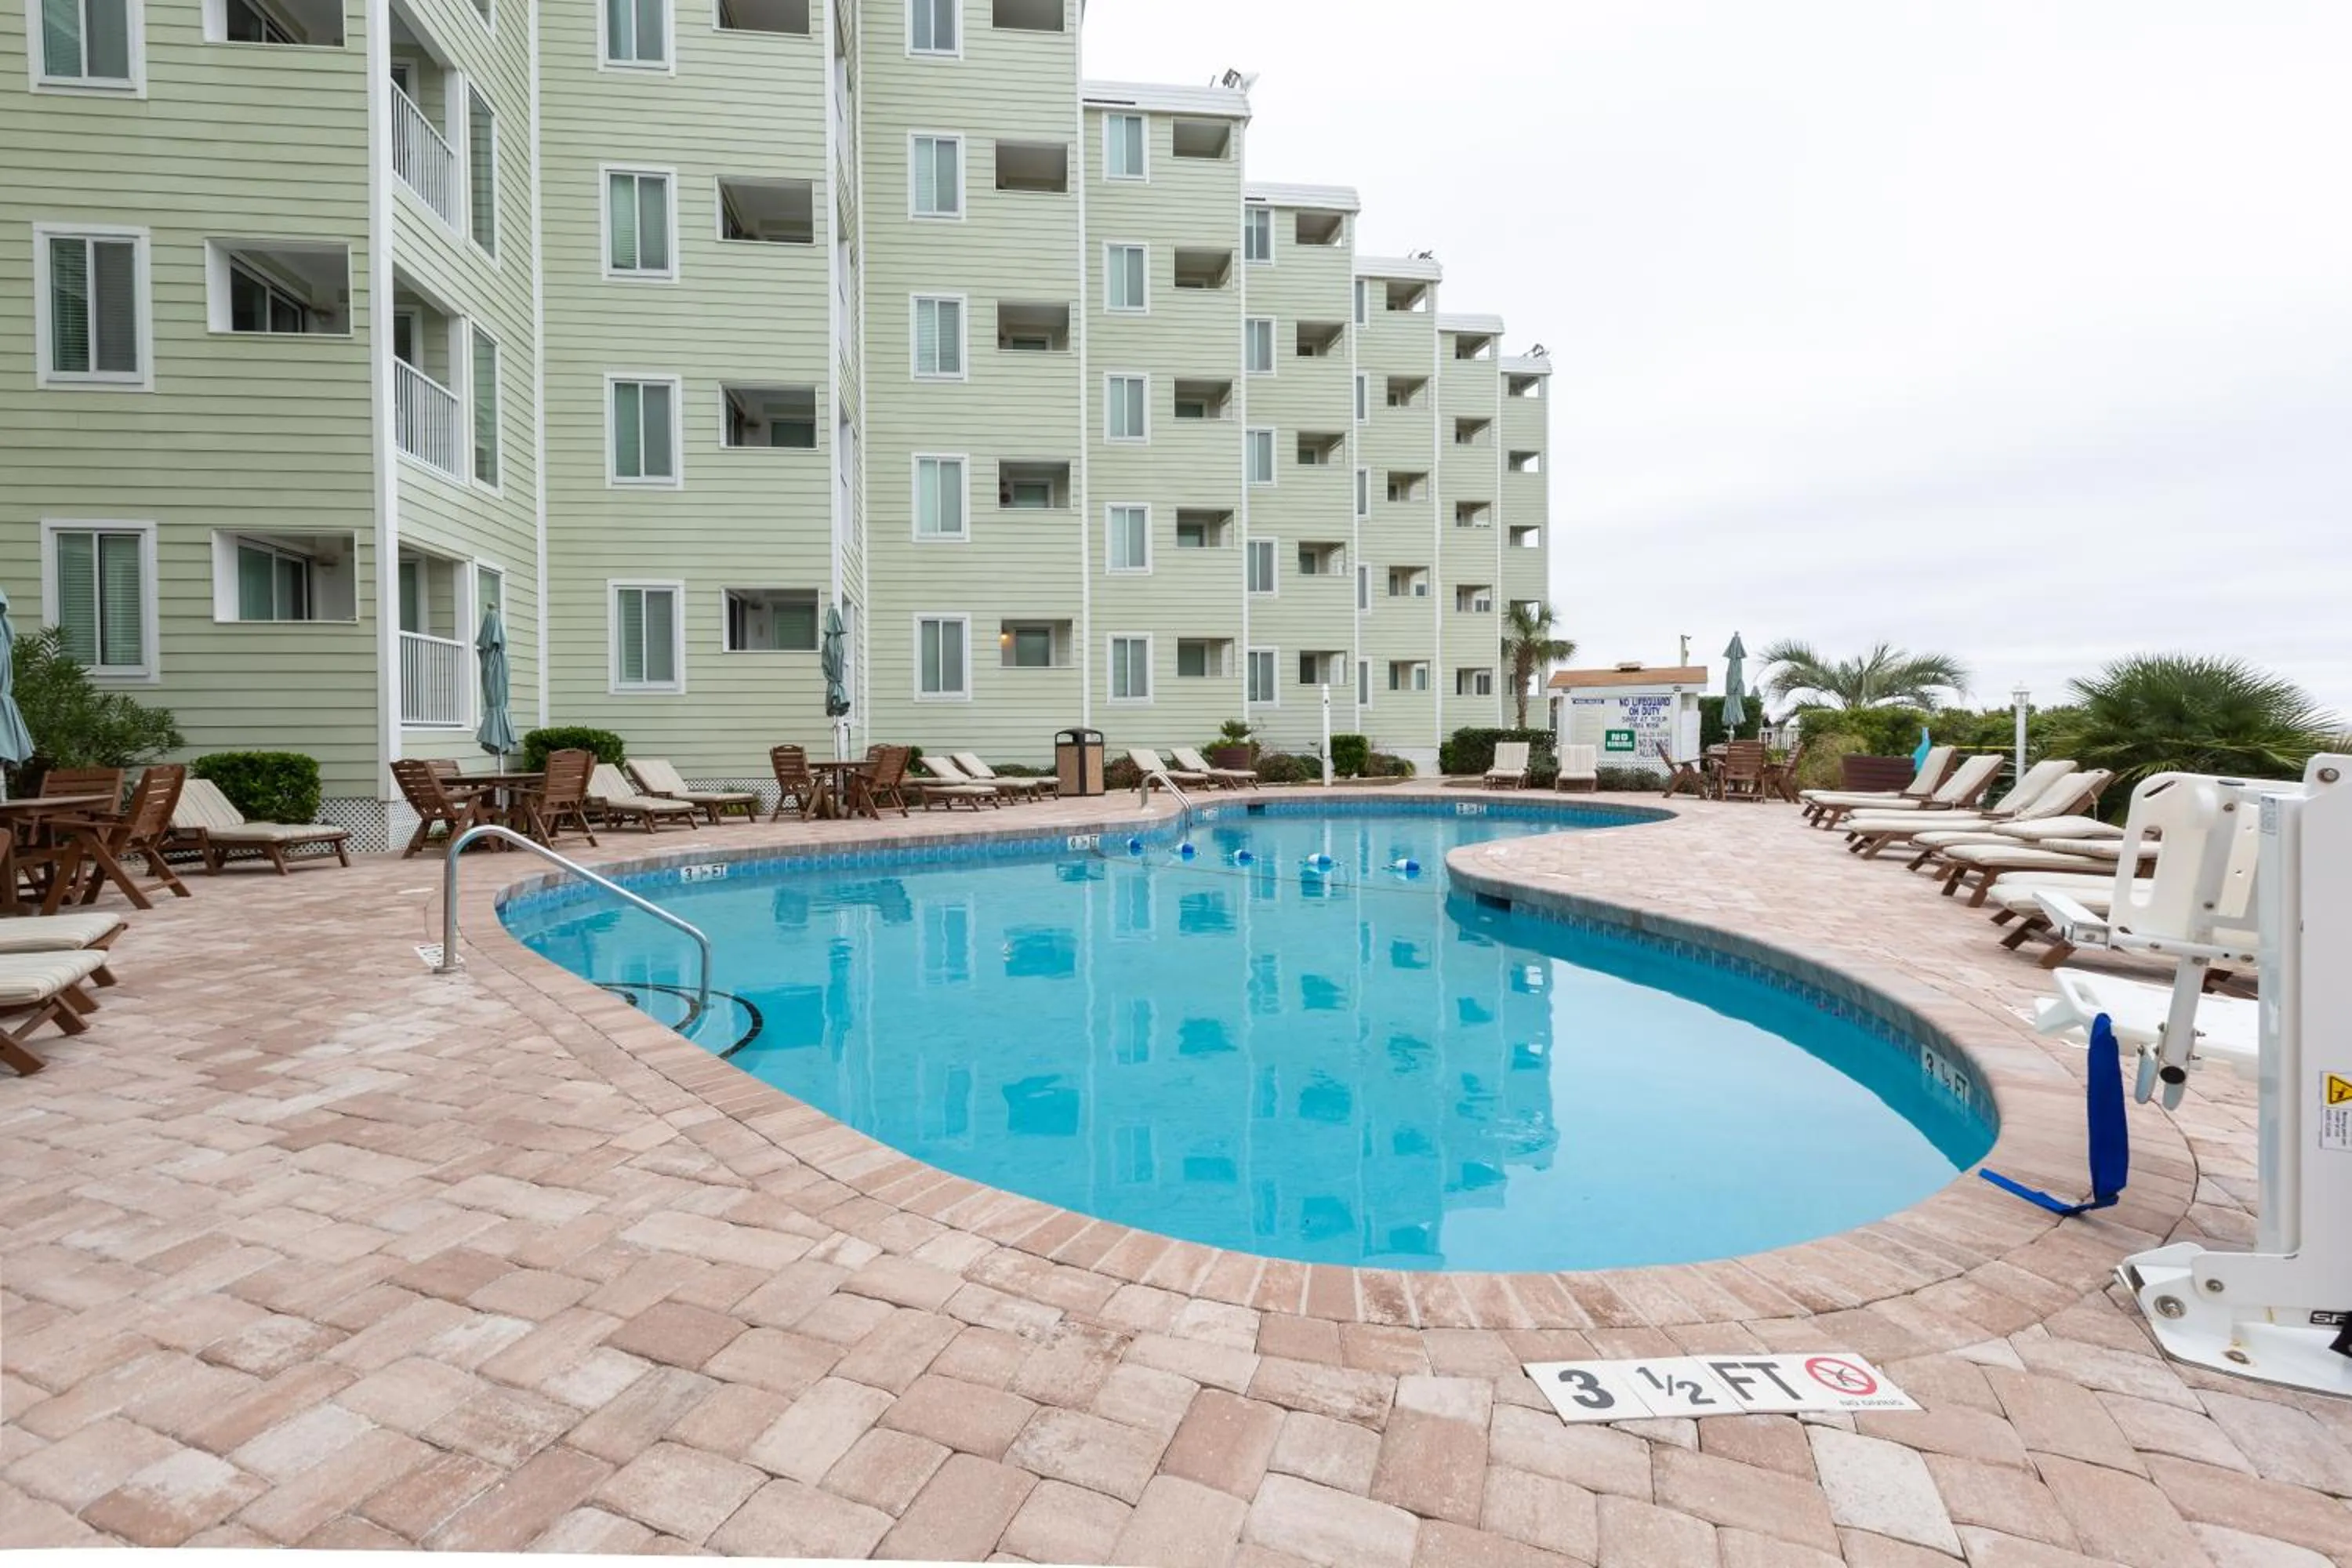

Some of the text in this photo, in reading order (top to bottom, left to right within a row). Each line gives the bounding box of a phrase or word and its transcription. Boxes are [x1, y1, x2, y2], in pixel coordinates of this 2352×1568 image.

[1619, 697, 1671, 706] NO LIFEGUARD
[1642, 706, 1661, 716] DUTY
[1558, 1369, 1616, 1409] 3
[1708, 1362, 1804, 1400] FT
